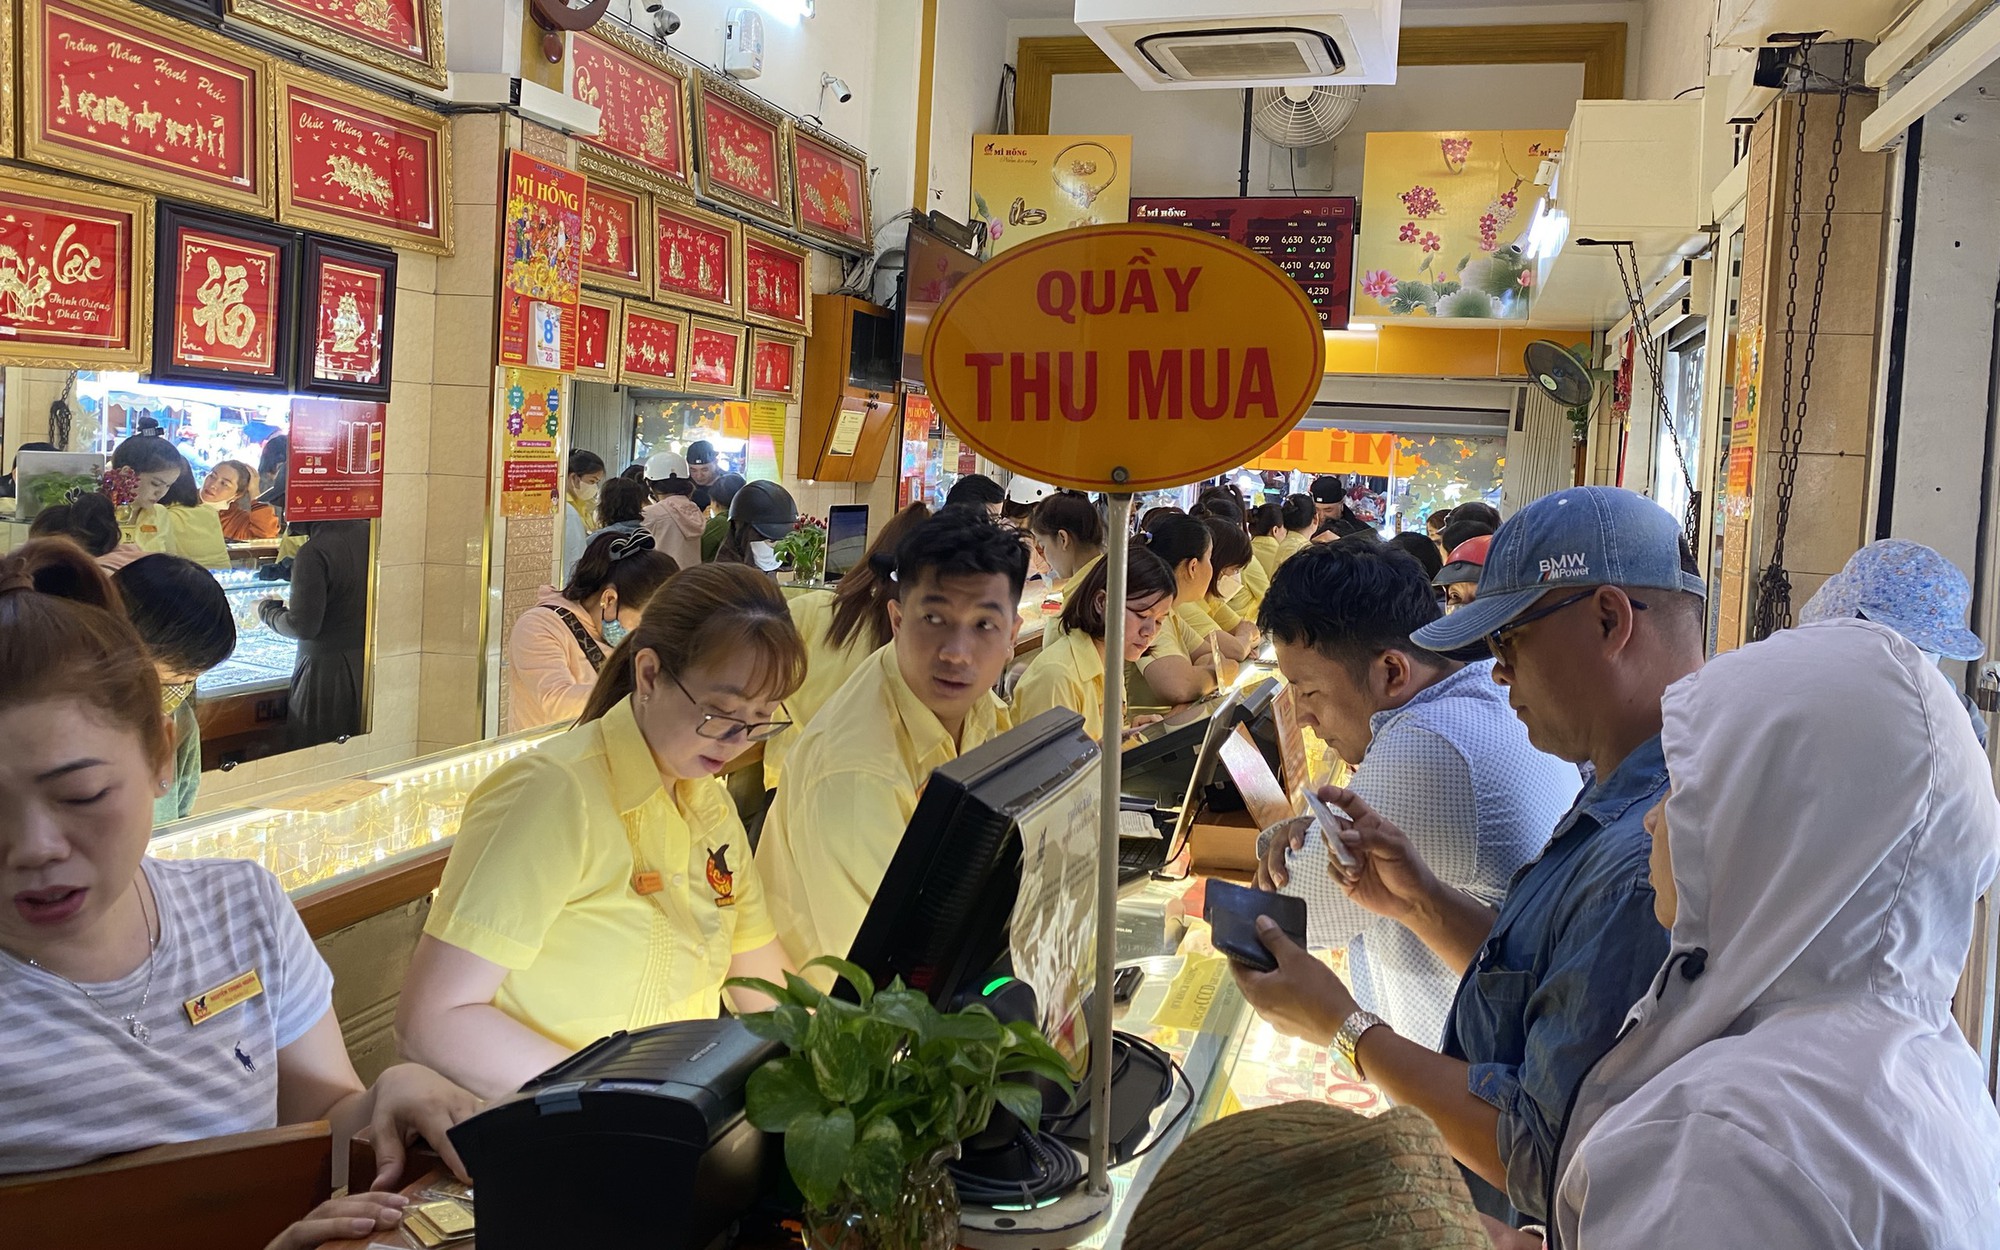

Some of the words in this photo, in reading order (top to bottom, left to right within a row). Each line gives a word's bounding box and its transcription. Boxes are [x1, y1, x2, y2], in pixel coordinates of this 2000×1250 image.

[58, 33, 98, 53] Trăm
[107, 42, 143, 64] Năm
[153, 58, 188, 83] Hạnh
[197, 76, 227, 104] Phúc
[299, 112, 325, 130] Chúc
[332, 118, 363, 142] Mừng
[397, 146, 415, 161] Gia
[537, 177, 579, 212] HỒNG
[52, 223, 104, 284] Lộc
[1254, 235, 1270, 244] 999
[1281, 235, 1303, 245] 6,630
[1310, 235, 1332, 245] 6,730
[1280, 261, 1301, 270] 4,610
[1309, 261, 1331, 270] 4,760
[194, 256, 257, 349] 福
[1036, 247, 1203, 324] QUẦY
[1307, 287, 1330, 296] 4,230
[544, 319, 554, 344] 8
[1318, 312, 1328, 320] 30
[965, 351, 1098, 422] THU
[1127, 347, 1279, 420] MUA
[1539, 553, 1586, 572] BMW
